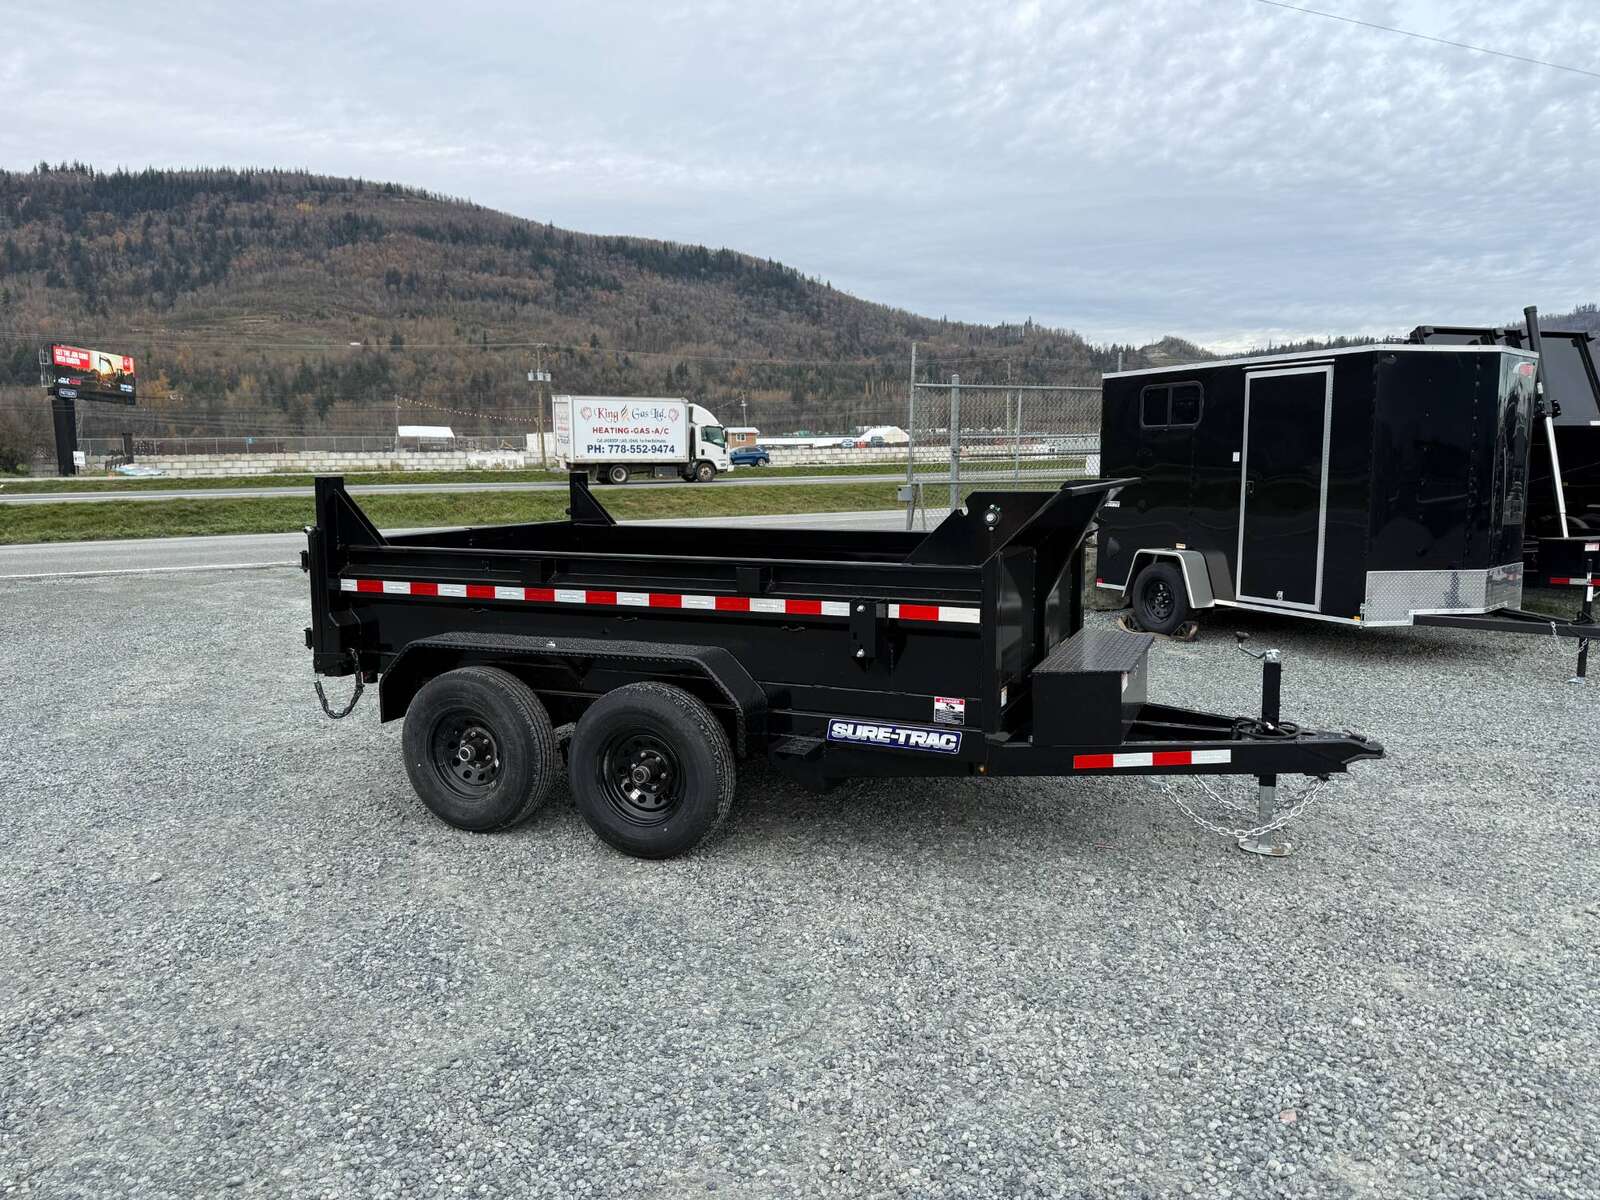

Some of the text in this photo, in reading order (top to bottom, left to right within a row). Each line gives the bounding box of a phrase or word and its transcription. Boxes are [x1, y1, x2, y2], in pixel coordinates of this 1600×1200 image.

[595, 408, 619, 422] King
[632, 408, 648, 420] Gas
[586, 444, 675, 454] PH: 778-552-9474
[831, 722, 958, 750] SURE-TRAC
